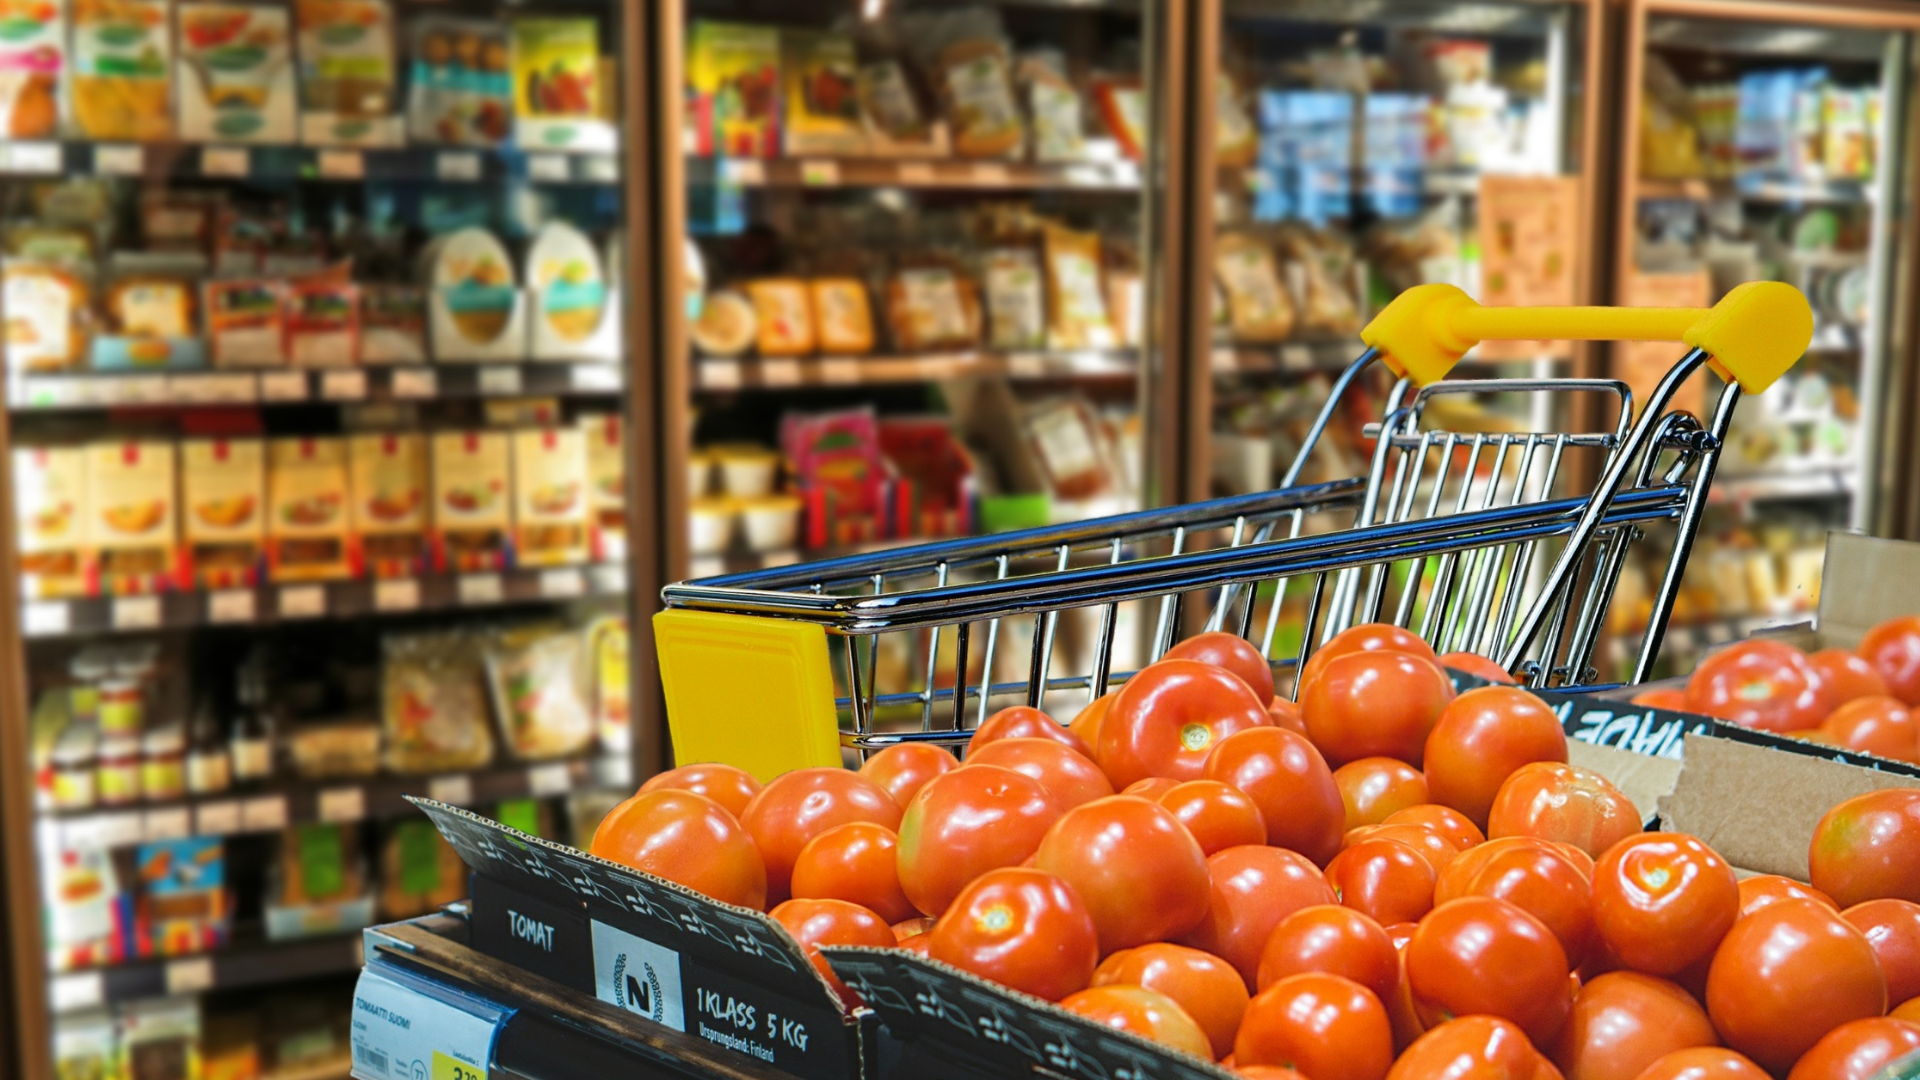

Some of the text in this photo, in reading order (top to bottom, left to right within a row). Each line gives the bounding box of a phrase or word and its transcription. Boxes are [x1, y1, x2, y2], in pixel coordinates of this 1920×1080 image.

[507, 909, 555, 952] TOMAT
[356, 998, 410, 1029] TOMAATTI SUOMI
[626, 974, 650, 1013] N
[697, 987, 808, 1052] 1 KLASS 5 KG
[699, 1021, 775, 1063] Ursprungsland: Finland
